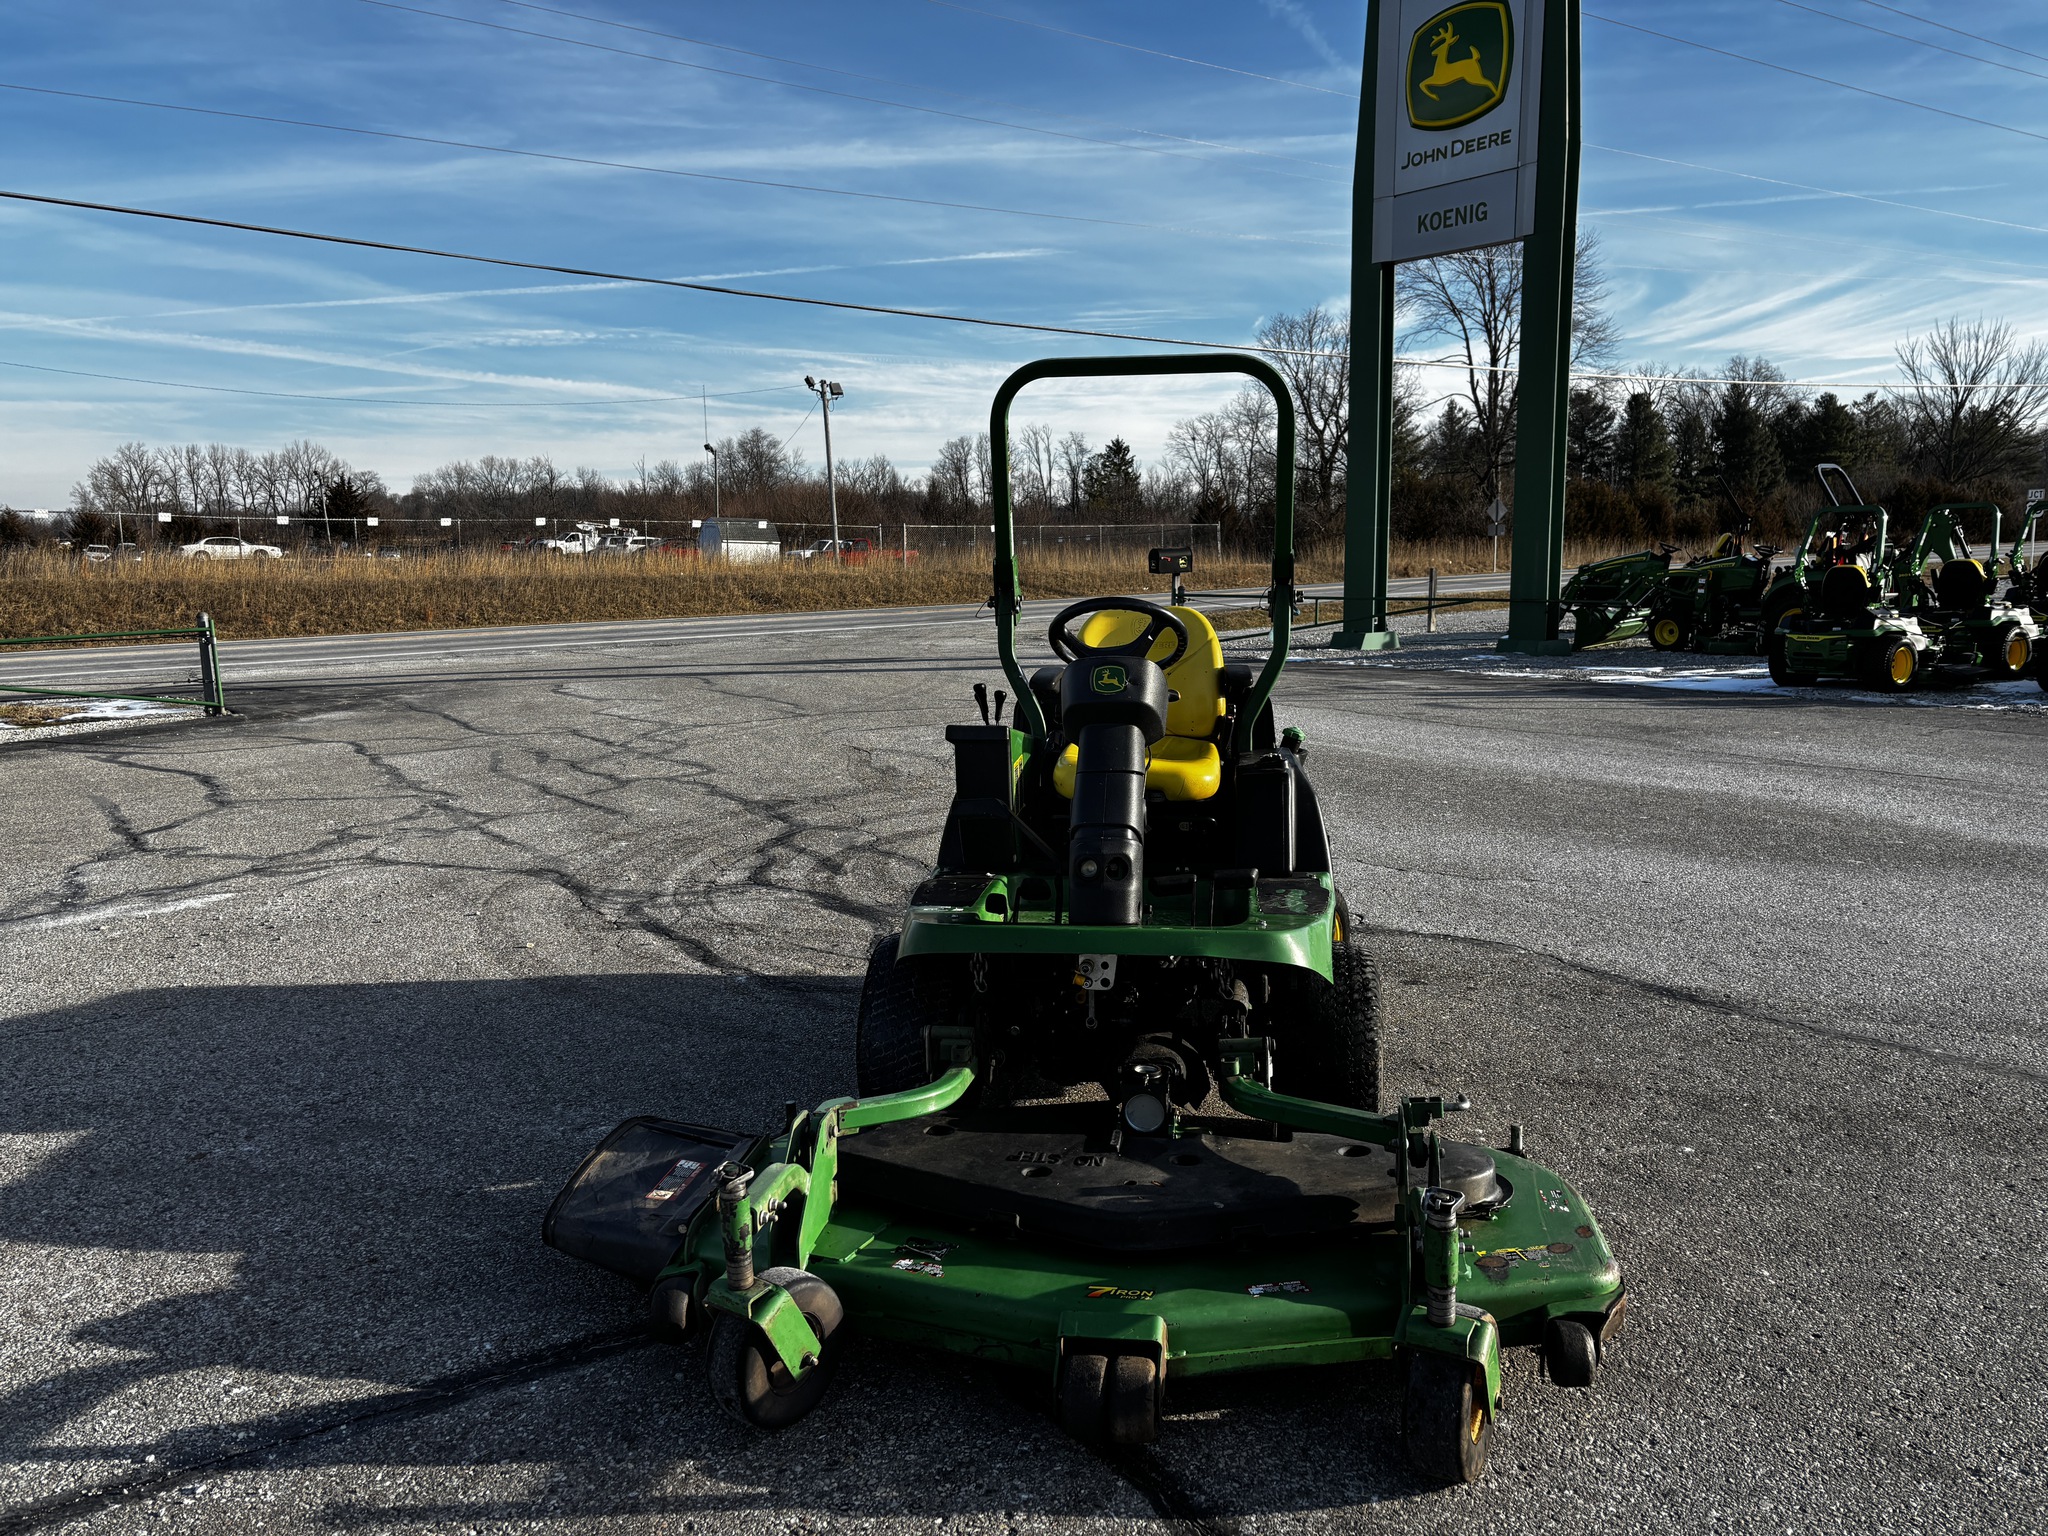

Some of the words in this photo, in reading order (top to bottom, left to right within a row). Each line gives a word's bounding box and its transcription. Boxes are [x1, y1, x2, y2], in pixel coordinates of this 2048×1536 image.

[1401, 145, 1448, 170] JOHN
[1451, 129, 1511, 157] DEERE
[1417, 202, 1487, 234] KOENIG
[2029, 490, 2043, 499] JCT
[1005, 1150, 1062, 1165] STEP
[1073, 1155, 1106, 1167] NO
